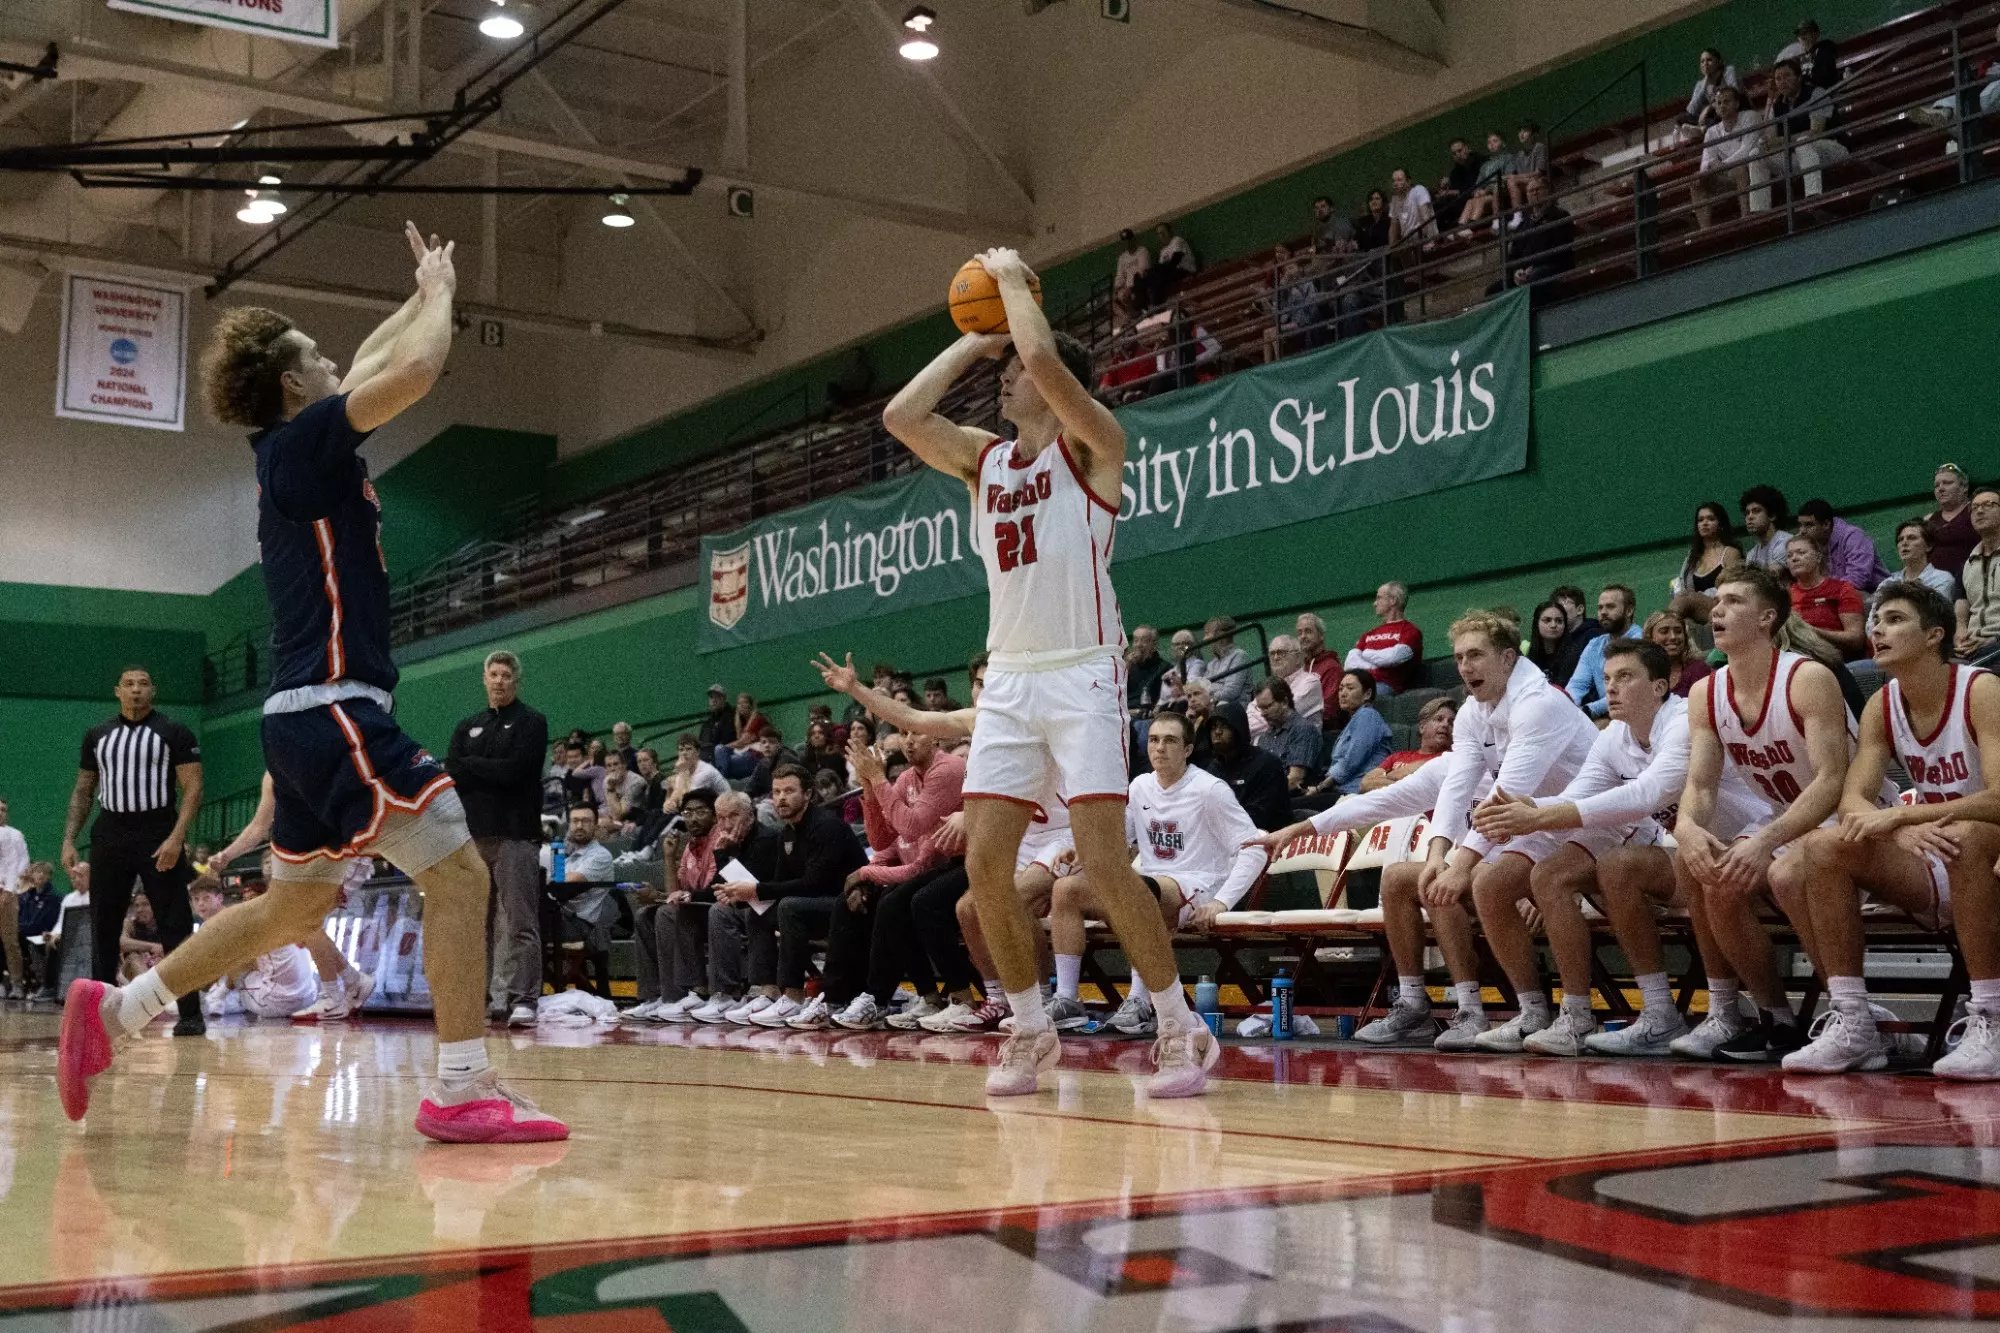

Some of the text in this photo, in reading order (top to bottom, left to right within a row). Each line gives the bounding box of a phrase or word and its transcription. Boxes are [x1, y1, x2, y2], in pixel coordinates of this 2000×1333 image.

[731, 190, 751, 216] C
[93, 290, 162, 308] WASHINGTON
[95, 304, 158, 321] UNIVERSITY
[484, 322, 501, 345] B
[97, 380, 149, 395] NATIONAL
[90, 393, 153, 411] CHAMPIONS
[753, 508, 963, 609] Washington
[1206, 417, 1262, 499] in
[1337, 349, 1495, 467] Louis
[995, 514, 1037, 572] 21
[1726, 740, 1796, 770] WashU
[1147, 831, 1184, 851] WASH
[1286, 831, 1340, 860] BEARS
[1367, 825, 1424, 853] BES
[1280, 988, 1289, 1031] POWERADE
